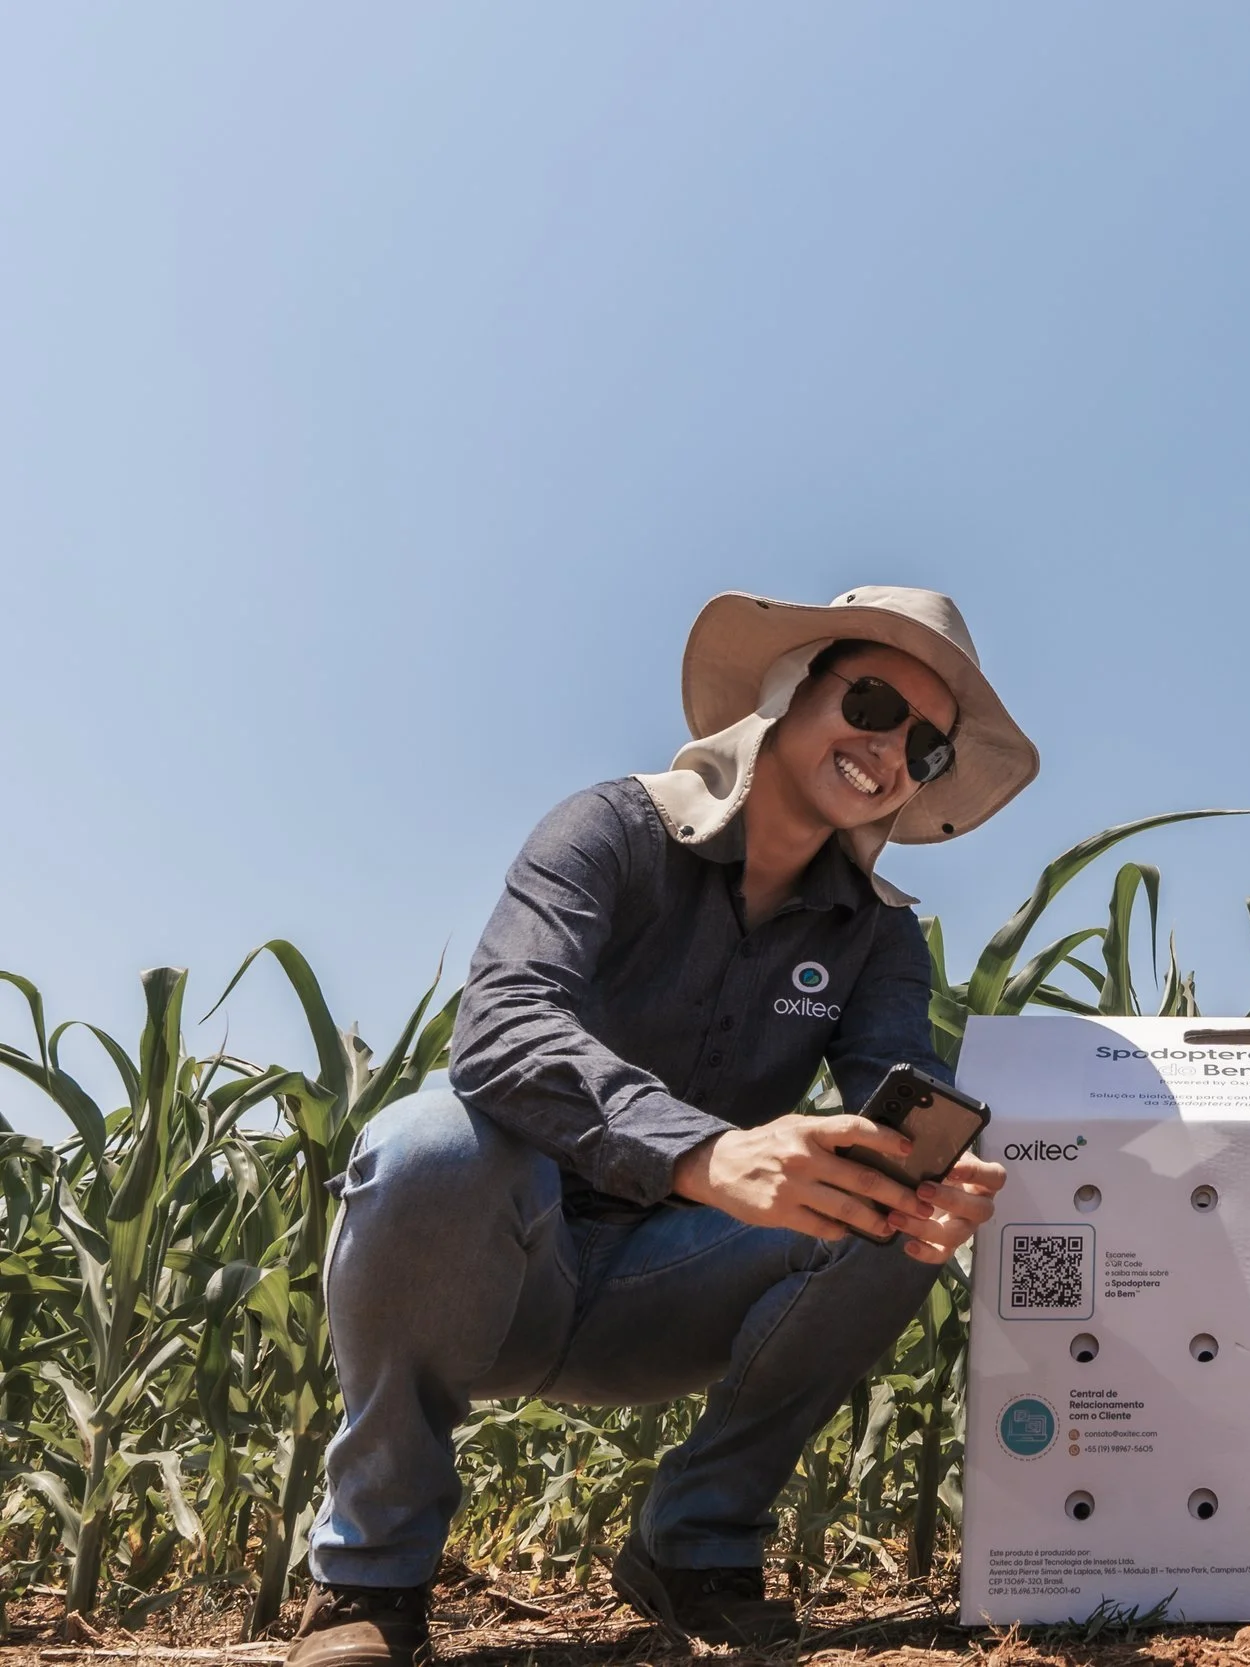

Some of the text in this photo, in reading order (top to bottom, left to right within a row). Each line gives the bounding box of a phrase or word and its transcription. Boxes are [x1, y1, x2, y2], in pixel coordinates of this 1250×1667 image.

[773, 997, 841, 1021] oxitec
[1158, 1064, 1197, 1077] do
[1160, 1079, 1208, 1087] Powered
[1213, 1079, 1226, 1087] by
[1090, 1092, 1135, 1101] Solução
[1139, 1092, 1193, 1102] biológica
[1163, 1100, 1231, 1108] Spodoptera
[1004, 1139, 1079, 1161] oxitec
[1112, 1280, 1160, 1288] Spodoptera
[1070, 1390, 1117, 1398] Central de
[1069, 1401, 1144, 1409] Relacionamento
[1099, 1412, 1131, 1420] Cliente
[1098, 1445, 1109, 1453] (19)
[1005, 1550, 1033, 1558] produto
[1040, 1550, 1076, 1558] produzido
[1077, 1550, 1091, 1558] por:
[1044, 1558, 1082, 1567] Tecnologia
[1074, 1568, 1102, 1576] Laplace,
[1191, 1566, 1208, 1574] Park,
